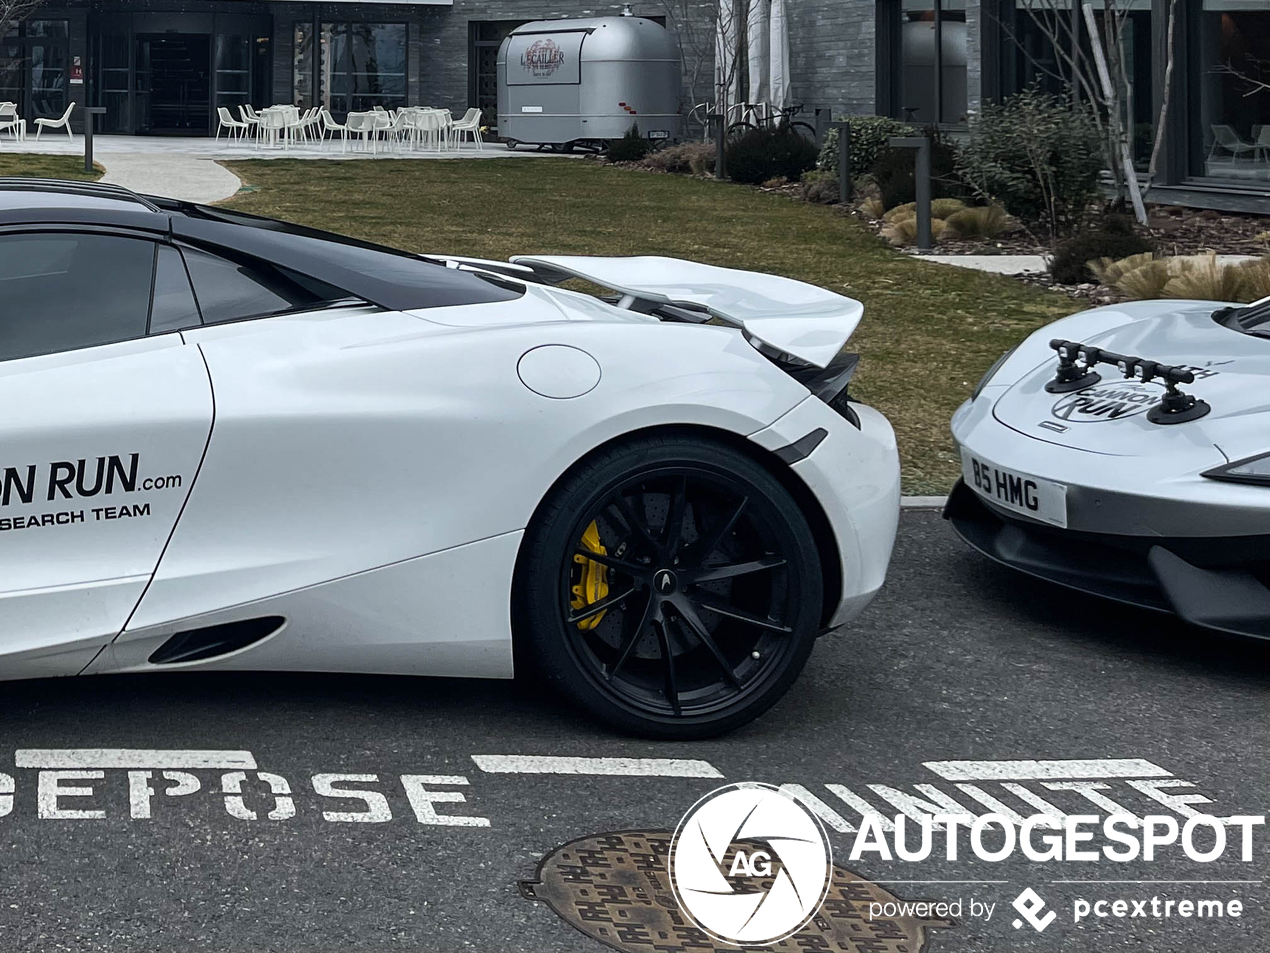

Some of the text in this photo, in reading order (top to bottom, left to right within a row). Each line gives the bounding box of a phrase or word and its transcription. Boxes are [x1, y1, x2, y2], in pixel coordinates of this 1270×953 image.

[1054, 398, 1142, 420] RUN
[972, 457, 1039, 512] B5 HMG
[91, 503, 151, 521] TEAM
